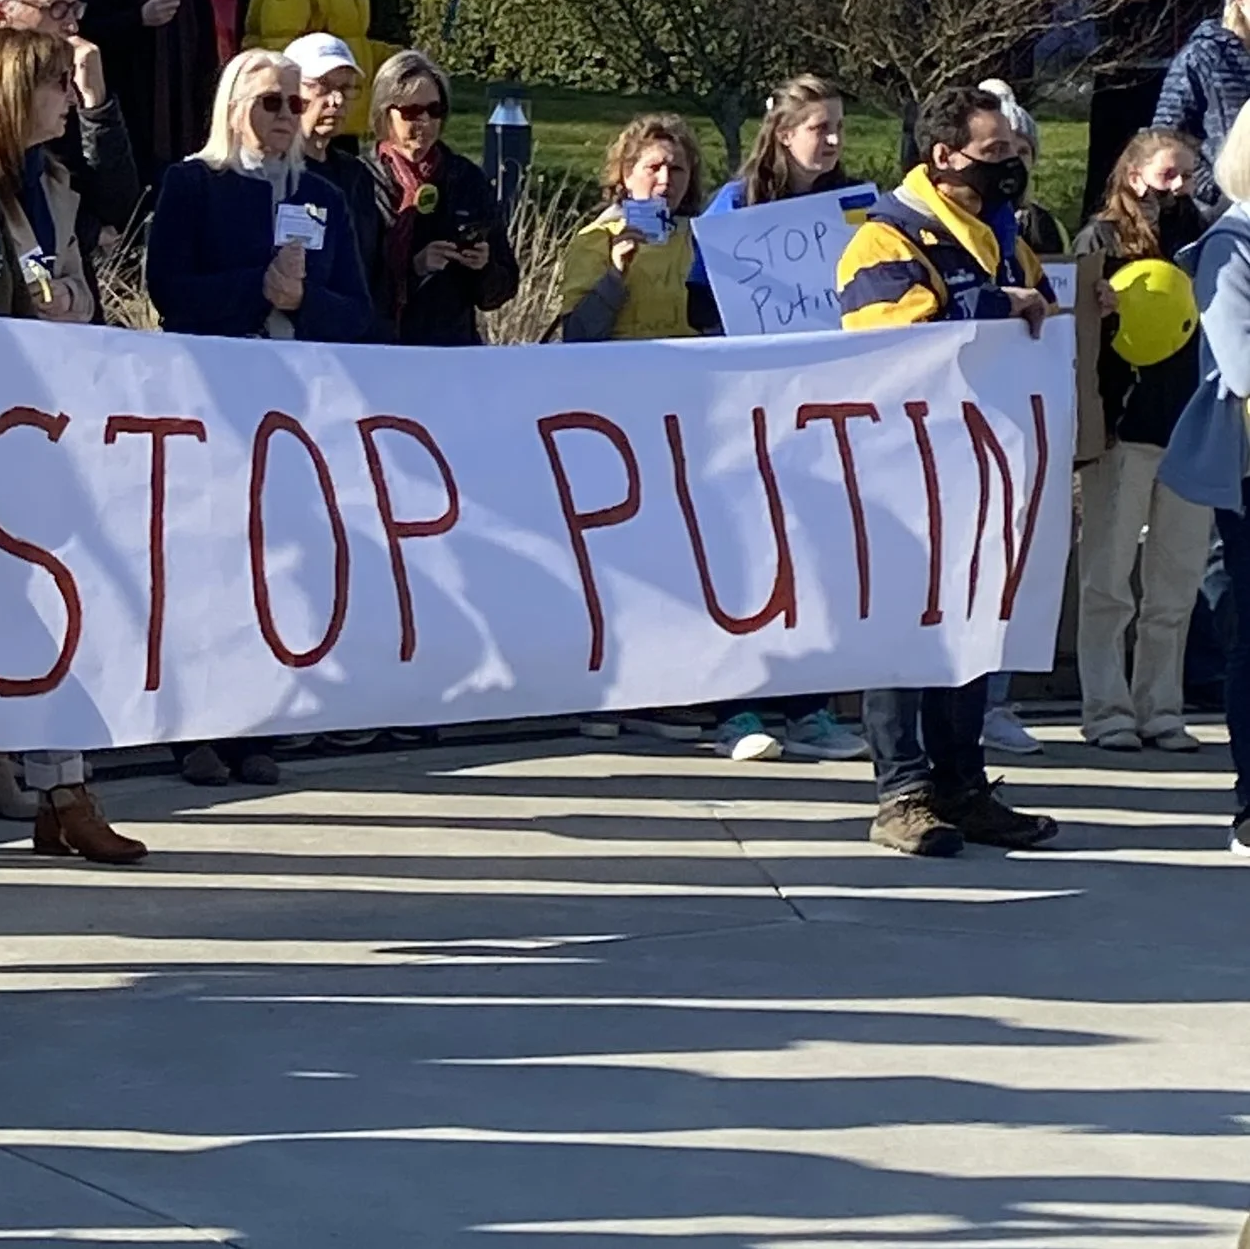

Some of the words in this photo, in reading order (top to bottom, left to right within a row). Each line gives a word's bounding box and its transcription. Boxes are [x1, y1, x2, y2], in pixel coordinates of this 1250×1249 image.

[733, 221, 827, 284] STOP
[751, 283, 843, 334] Putin
[538, 392, 1049, 672] PUTIN
